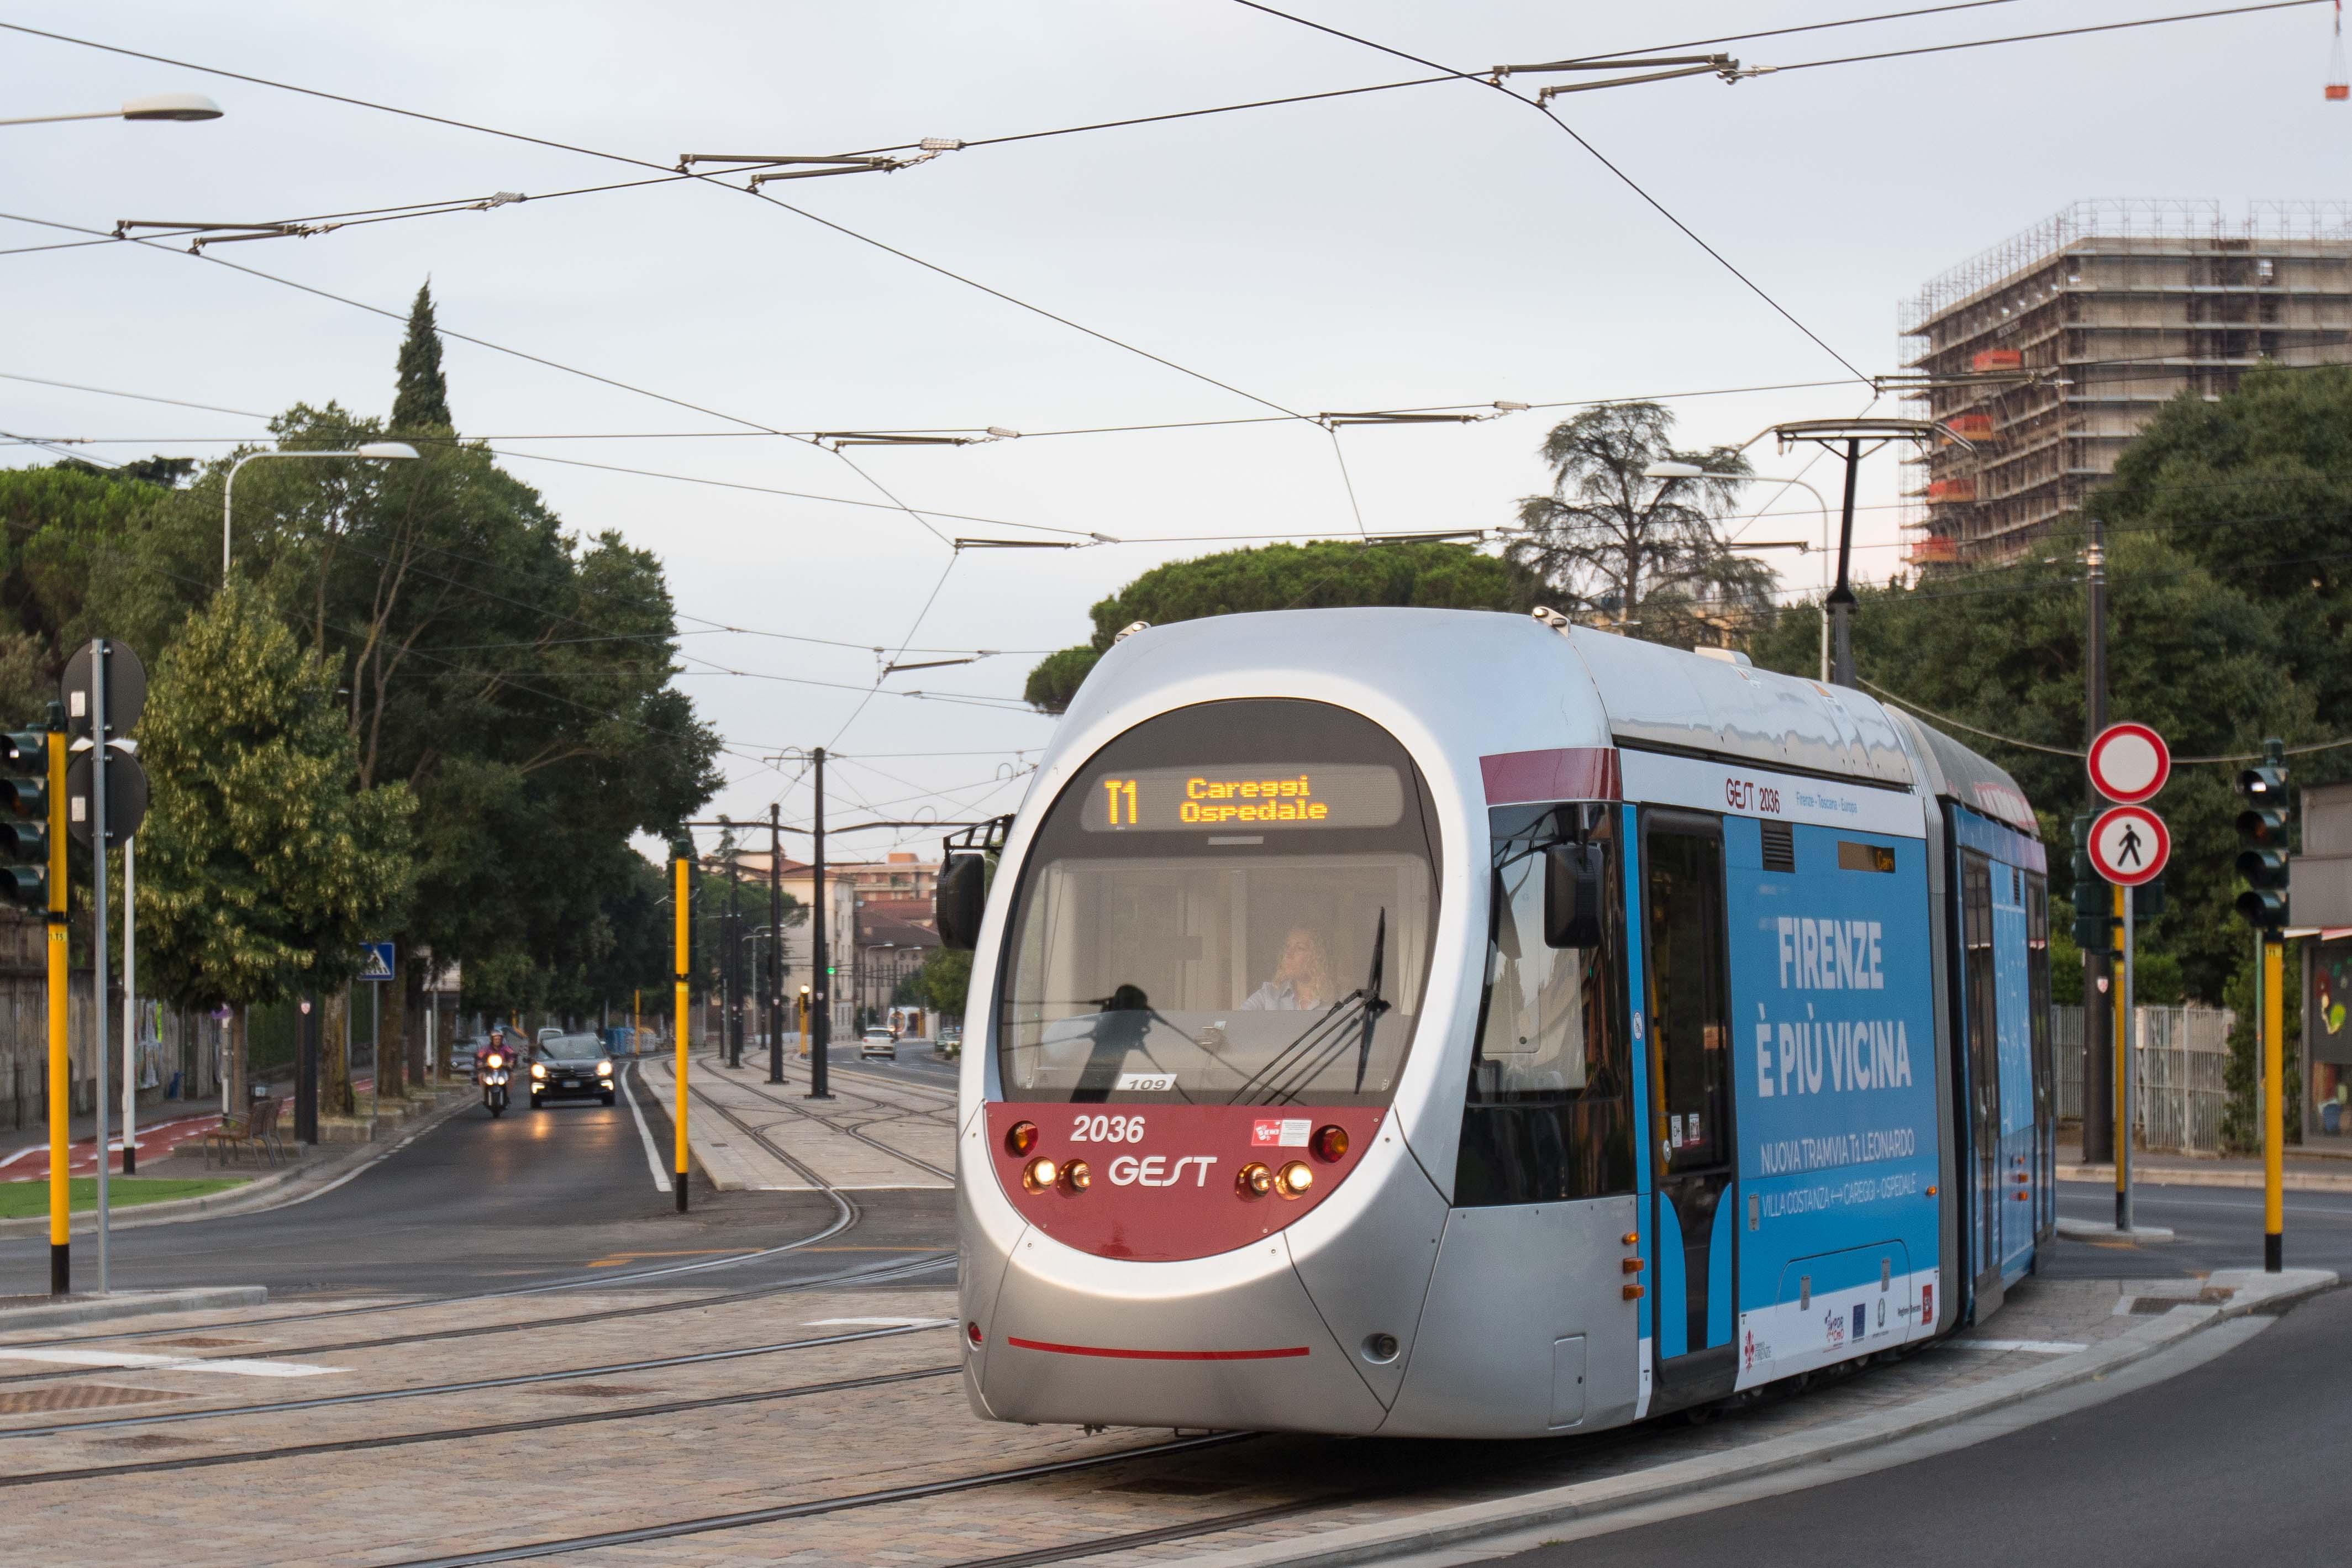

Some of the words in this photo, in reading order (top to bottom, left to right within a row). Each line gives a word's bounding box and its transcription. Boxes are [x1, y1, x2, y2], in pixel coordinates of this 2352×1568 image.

[1104, 780, 1136, 824] T1
[1187, 775, 1311, 799] Careggi
[1725, 778, 1754, 811] GEST
[1759, 787, 1780, 814] 2036
[1796, 791, 1814, 807] Firenze
[1818, 794, 1838, 810] Toscana
[1841, 798, 1858, 816] Europa
[1180, 799, 1328, 822] Ospedale
[1779, 917, 1884, 989] FIRENZE
[1756, 1003, 1774, 1097] È
[1779, 1003, 1823, 1096] PIÙ
[1827, 1020, 1912, 1092] VICINA
[1129, 1079, 1167, 1090] 109
[1070, 1115, 1145, 1143] 2036
[1761, 1140, 1801, 1175] NUOVA
[1802, 1135, 1849, 1169] TRAMVIA
[1862, 1128, 1914, 1161] LEONARDO
[1109, 1156, 1217, 1187] GEST
[1762, 1192, 1785, 1217] VILLA
[1786, 1187, 1830, 1214] COSTANZA
[1844, 1179, 1875, 1205] CAREGGI
[1881, 1171, 1917, 1198] OSPEDALE
